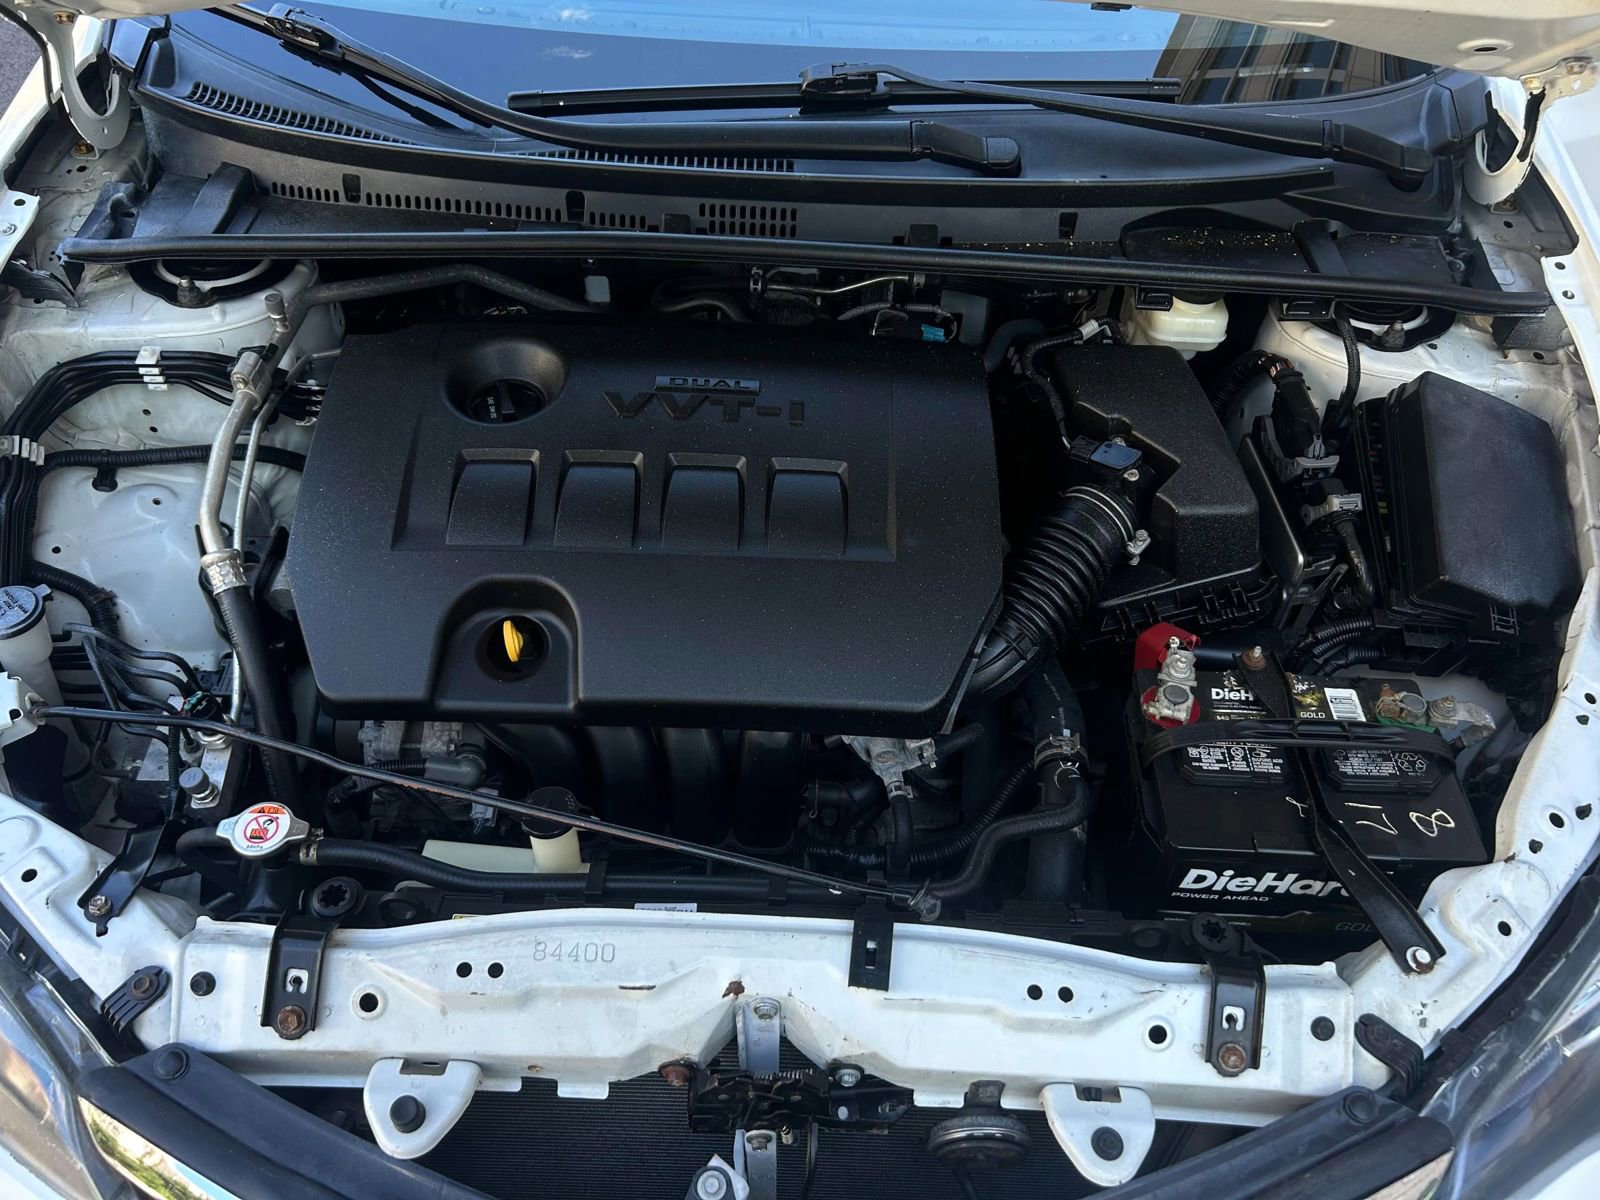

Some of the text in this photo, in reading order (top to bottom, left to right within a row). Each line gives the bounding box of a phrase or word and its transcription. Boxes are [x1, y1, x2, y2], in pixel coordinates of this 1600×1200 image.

[669, 377, 751, 390] DUAL
[1210, 687, 1254, 701] DieH
[1300, 711, 1326, 719] GOLD
[1178, 868, 1350, 897] DieHar
[1171, 891, 1219, 900] POWER
[1335, 922, 1376, 933] GOL
[533, 940, 616, 963] 84400
